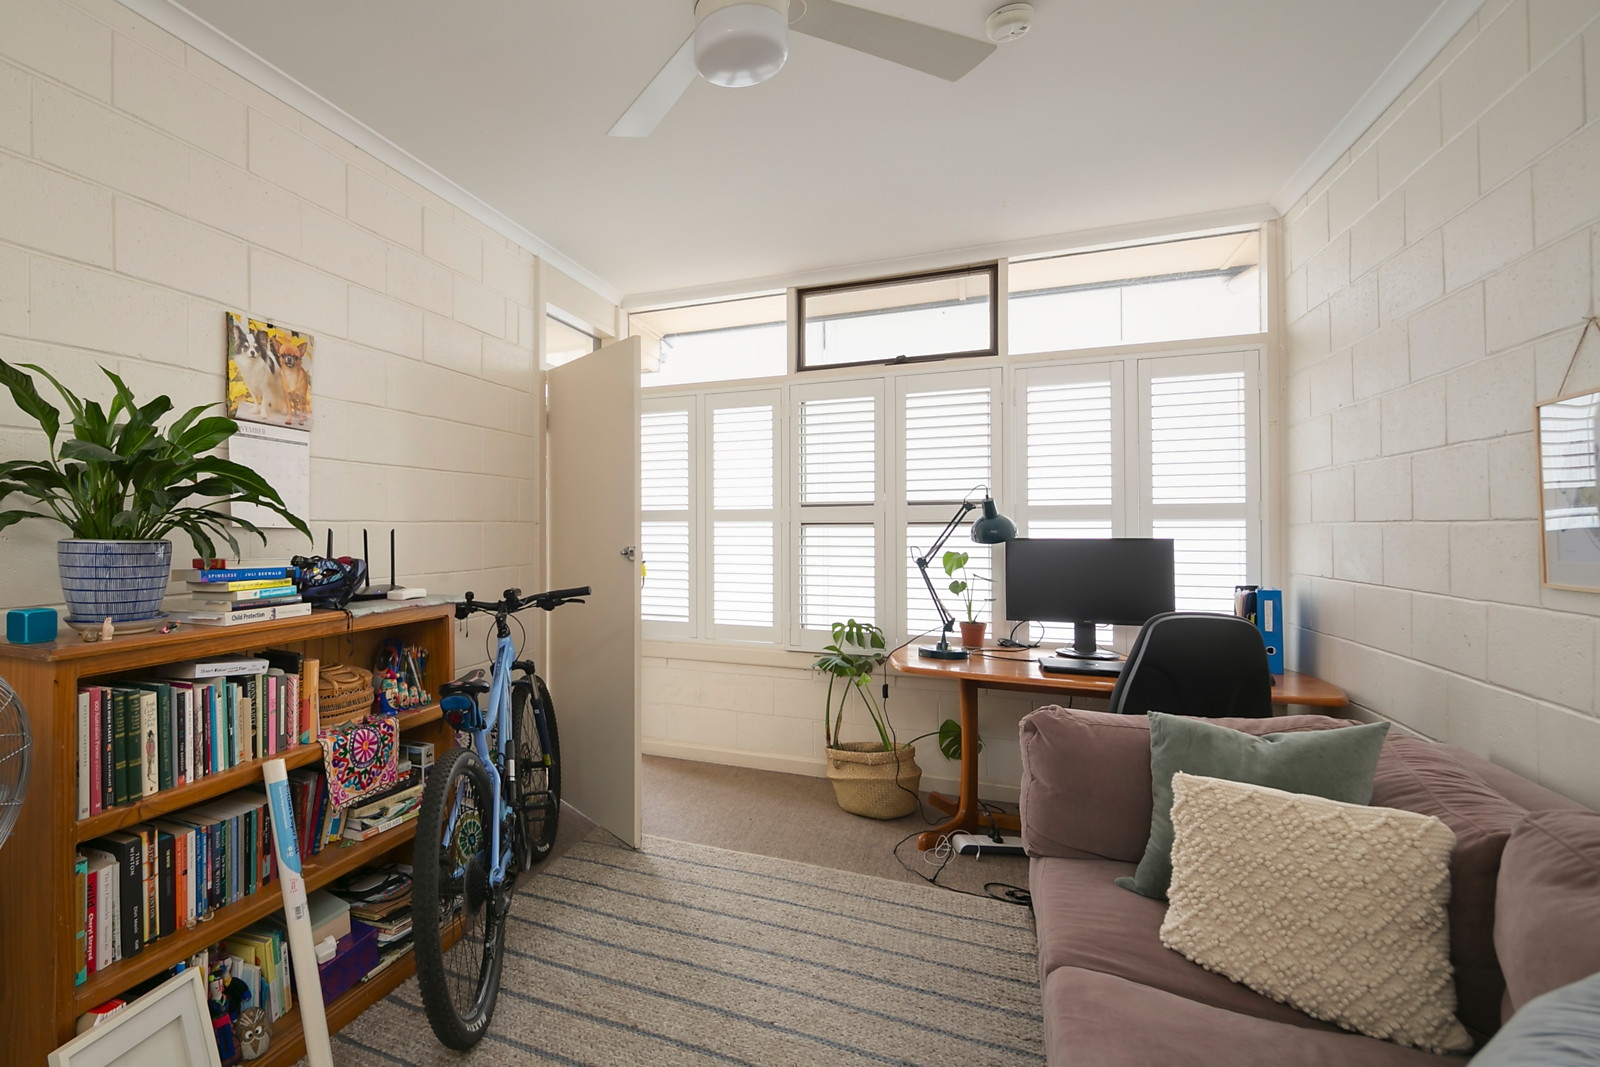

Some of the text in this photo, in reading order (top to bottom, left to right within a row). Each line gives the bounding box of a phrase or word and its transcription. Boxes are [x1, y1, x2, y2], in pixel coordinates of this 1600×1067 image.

[232, 612, 266, 621] Child Protection
[87, 884, 95, 909] wild
